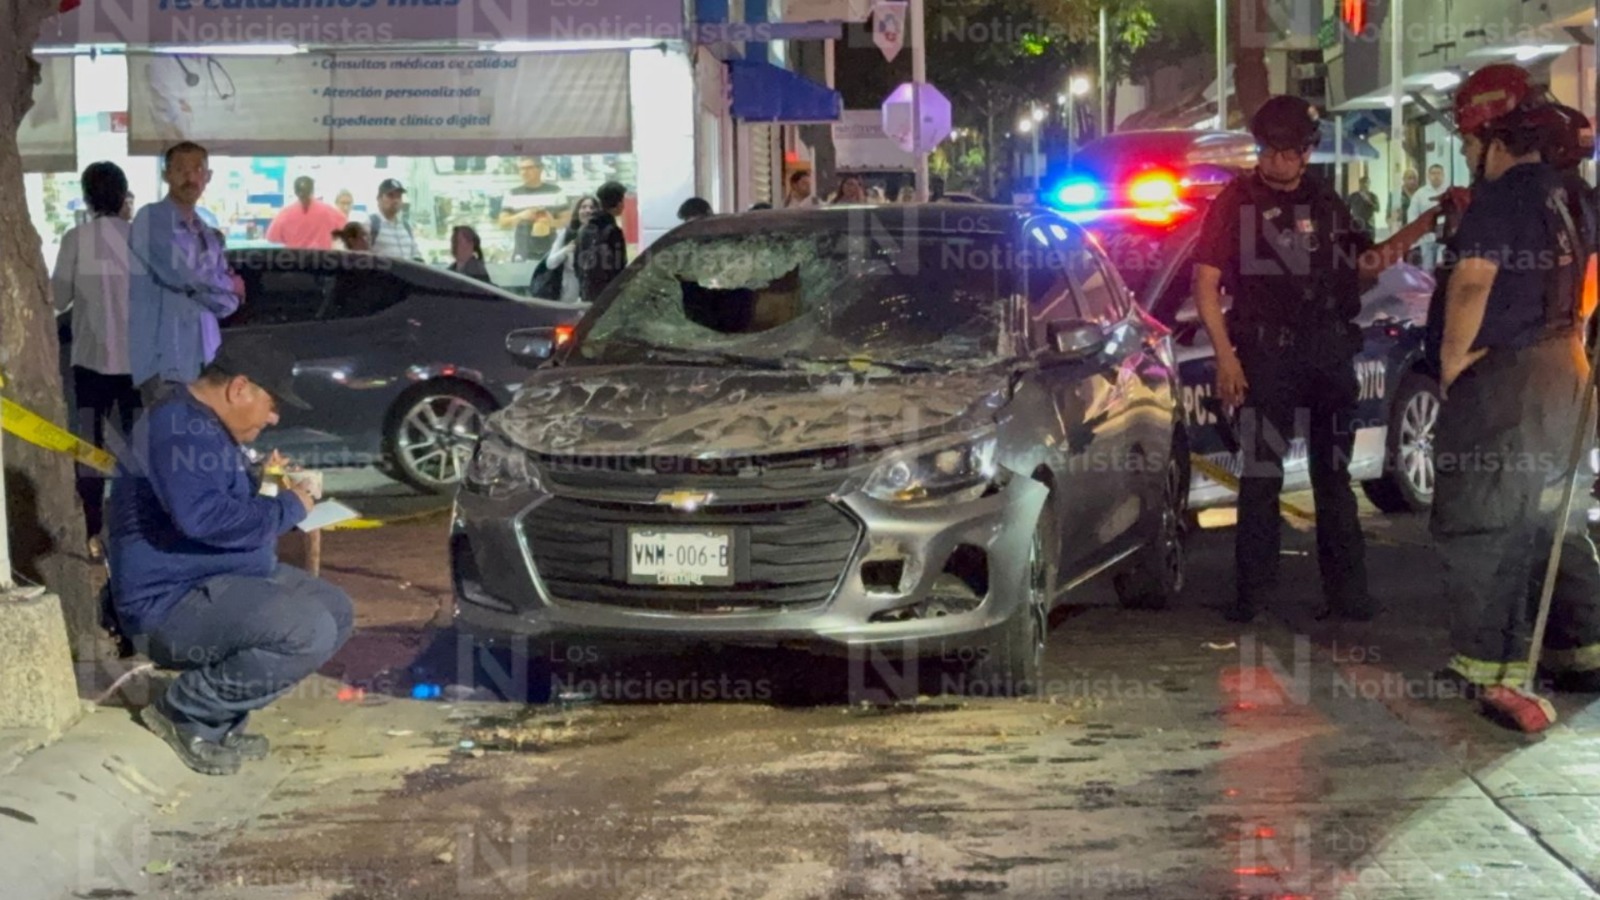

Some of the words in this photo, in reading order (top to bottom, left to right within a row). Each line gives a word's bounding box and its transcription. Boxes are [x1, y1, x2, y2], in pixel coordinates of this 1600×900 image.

[321, 58, 386, 69] Consultas
[389, 57, 445, 69] médicas
[448, 58, 465, 69] de
[467, 57, 518, 69] calidad
[322, 86, 382, 98] Atención
[384, 86, 481, 100] personalizada
[322, 114, 396, 128] Expediente
[400, 114, 443, 127] clínico
[446, 114, 491, 129] digital
[633, 544, 728, 567] VNM-006-B
